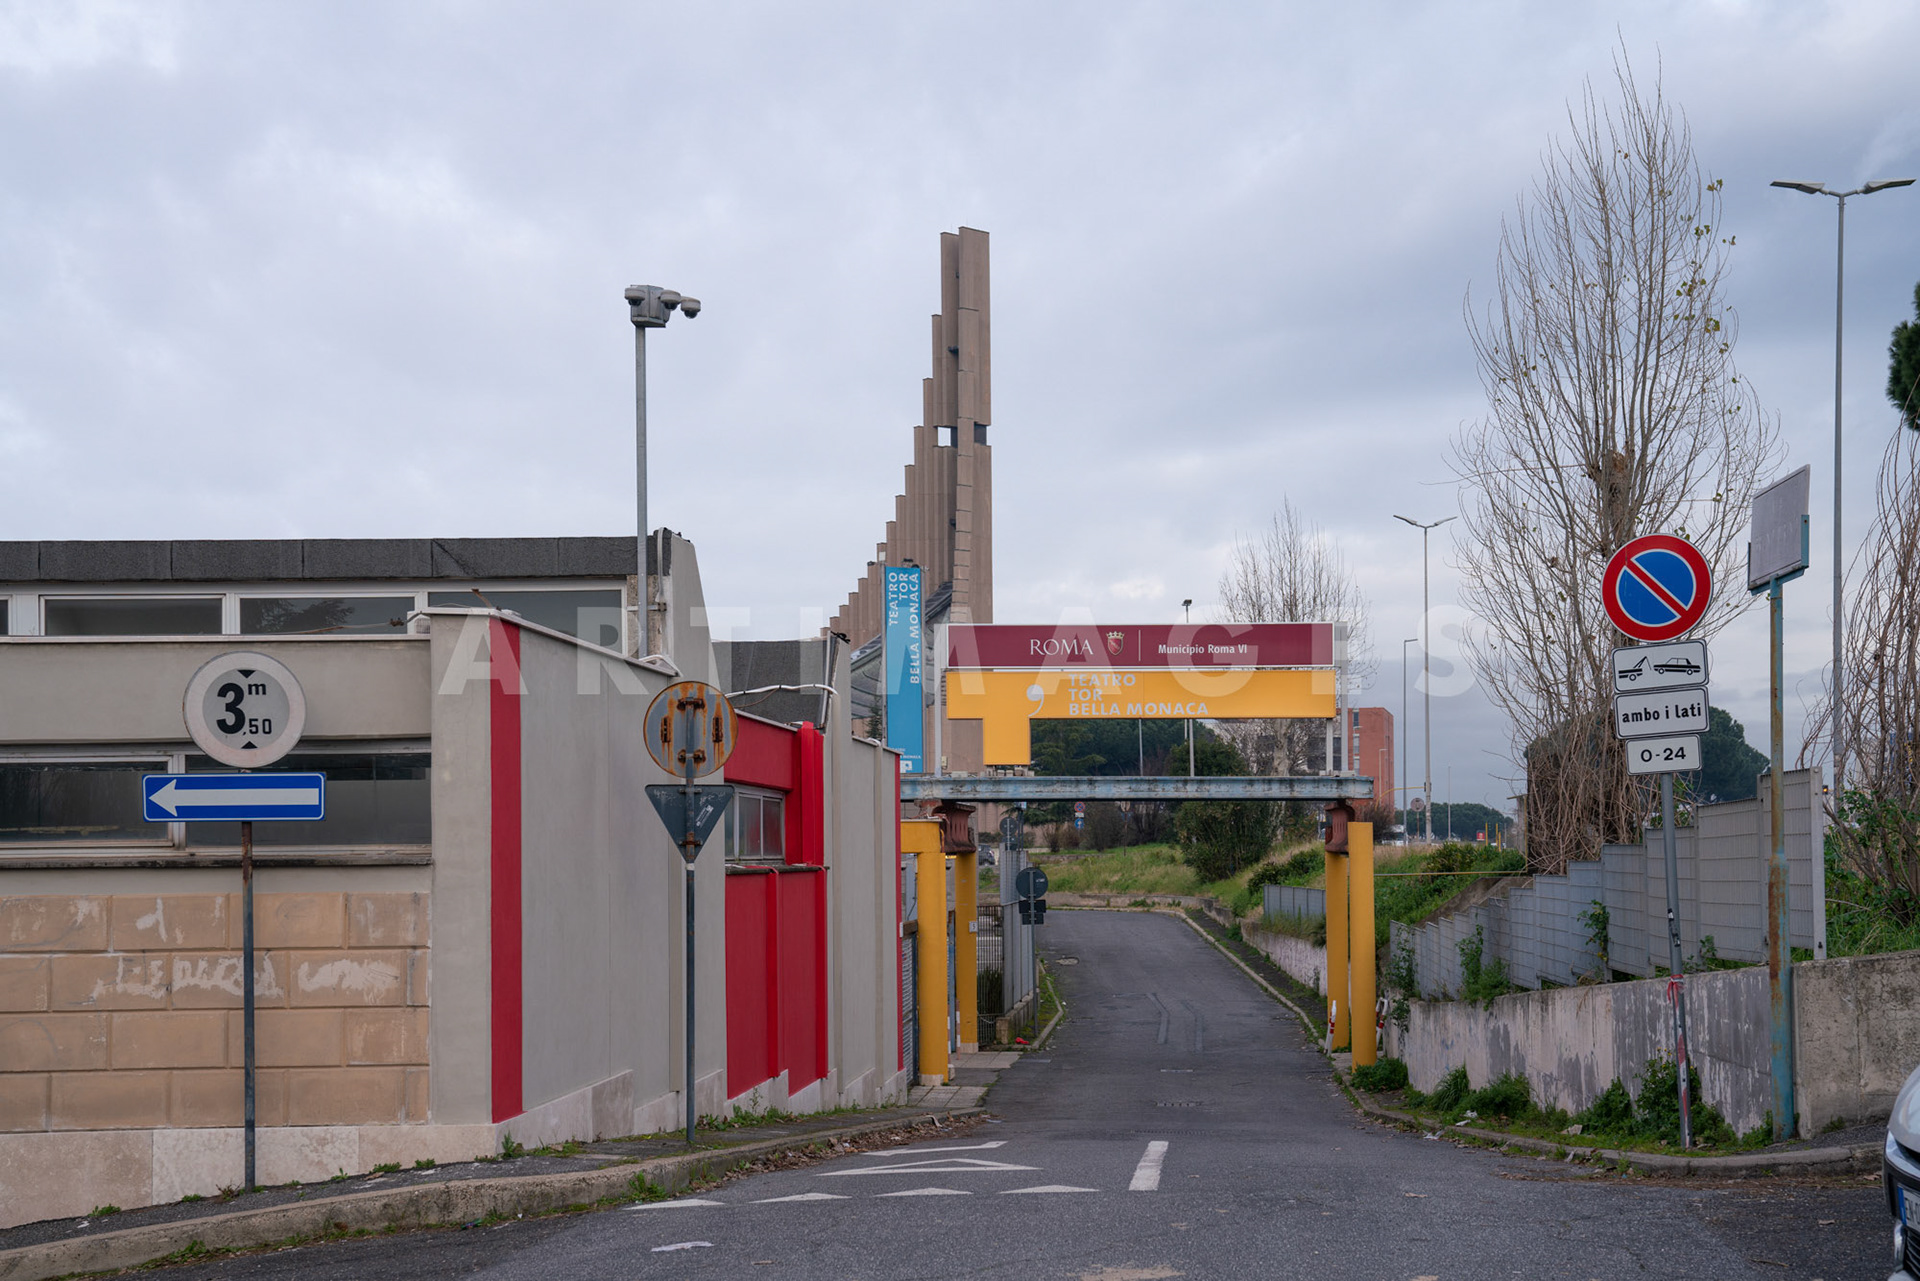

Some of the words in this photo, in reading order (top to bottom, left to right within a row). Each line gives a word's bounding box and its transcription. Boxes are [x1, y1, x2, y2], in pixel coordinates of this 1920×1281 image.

[898, 573, 908, 600] TOR
[888, 572, 898, 626] TEATRO
[908, 573, 920, 639] MONACA
[1030, 638, 1094, 656] ROMA
[1158, 644, 1205, 656] Municipio
[1207, 644, 1235, 655] Roma
[1238, 644, 1248, 654] VI
[909, 643, 920, 684] BELLA
[1068, 673, 1136, 687] TEATRO
[1068, 688, 1103, 701] TOR
[1069, 702, 1121, 716] BELLA
[1126, 702, 1209, 716] MONACA
[1622, 707, 1660, 723] ambo
[1665, 705, 1670, 720] i
[1675, 702, 1702, 719] lati
